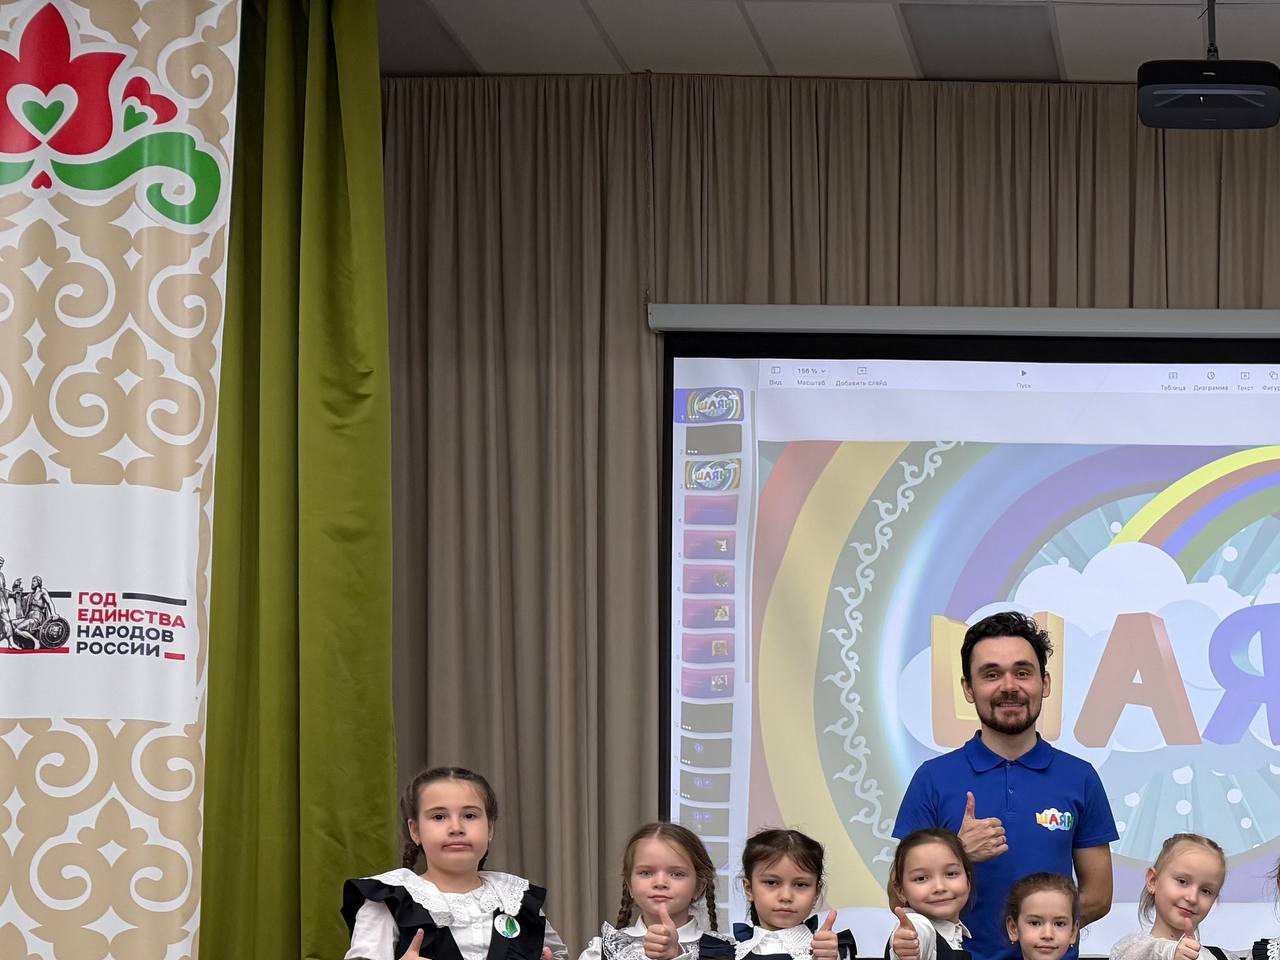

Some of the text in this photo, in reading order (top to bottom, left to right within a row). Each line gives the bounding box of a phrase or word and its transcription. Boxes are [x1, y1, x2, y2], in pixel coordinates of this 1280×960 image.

[78, 592, 117, 607] ГОД
[78, 608, 186, 628] ЕДИНСТВА
[76, 625, 175, 643] НАРОДОВ
[76, 641, 160, 657] РОССИИ
[1036, 813, 1074, 829] ШАЯН
